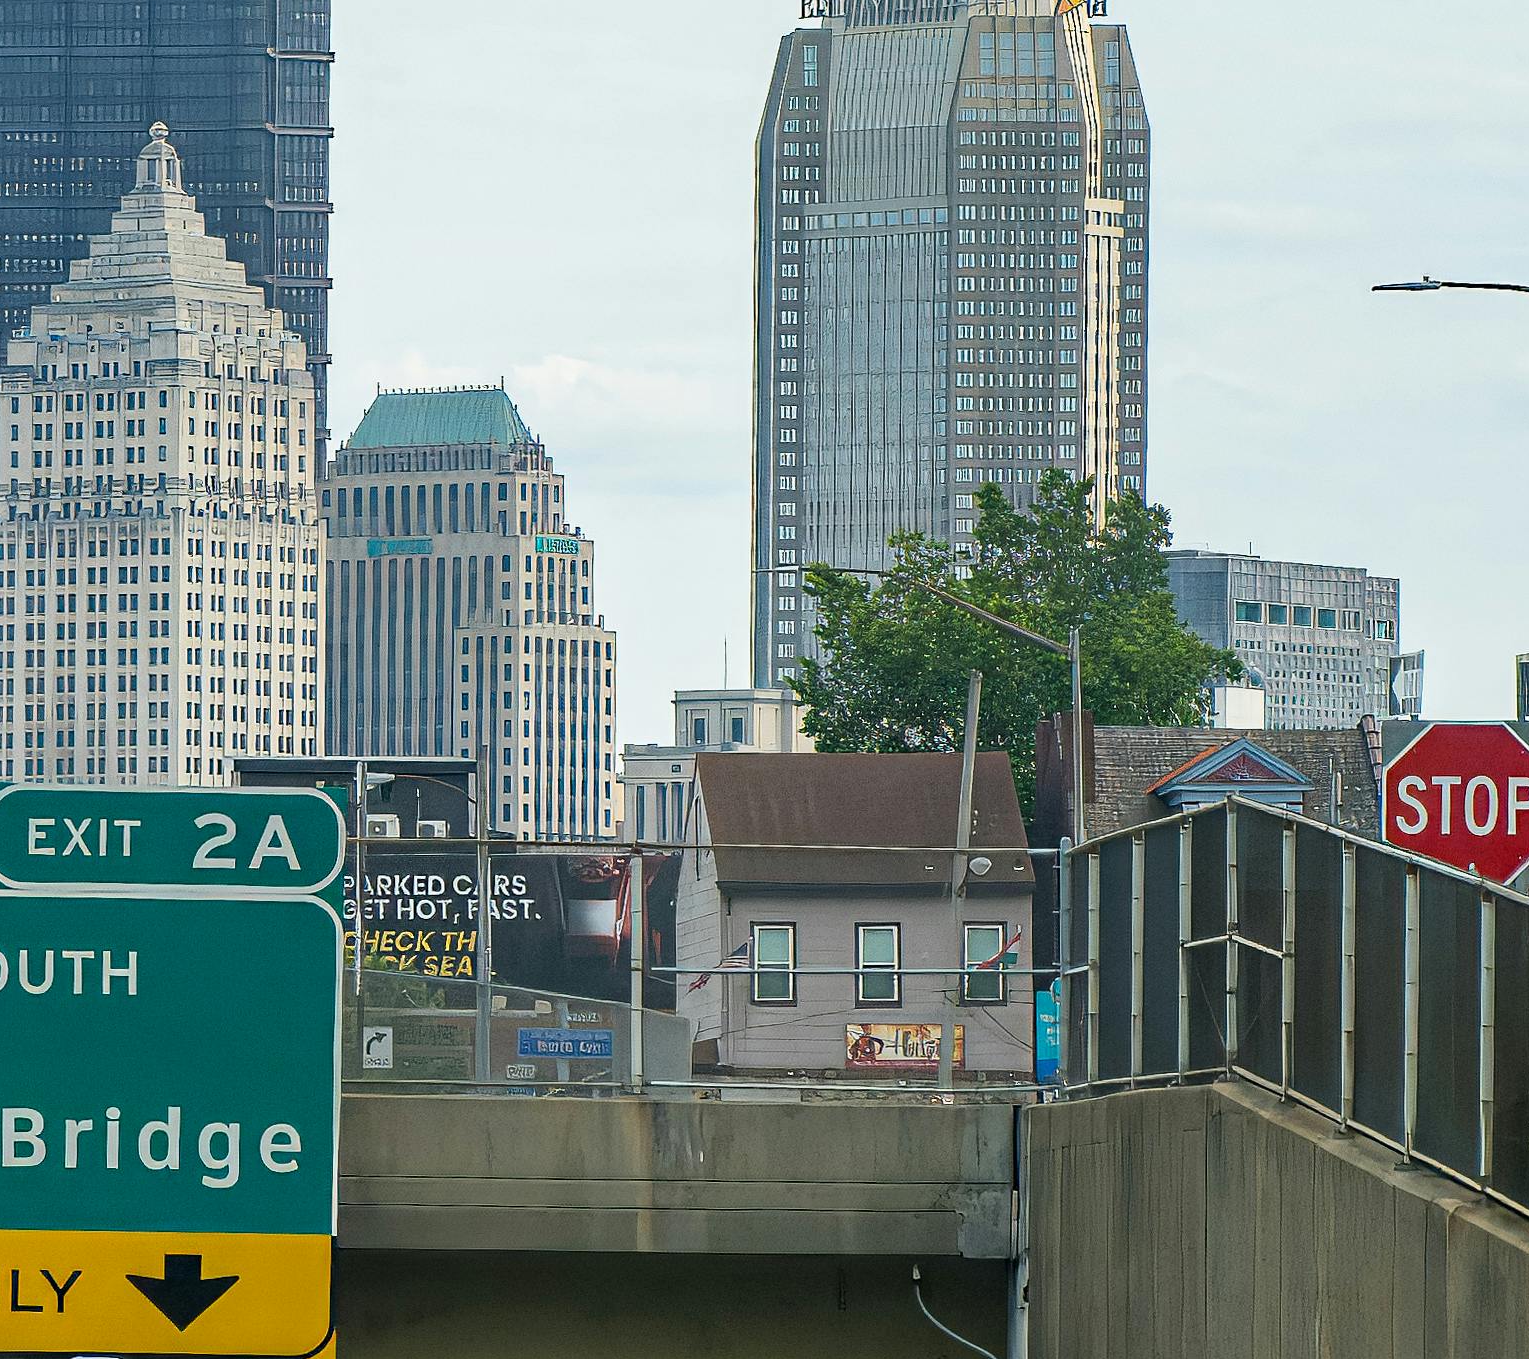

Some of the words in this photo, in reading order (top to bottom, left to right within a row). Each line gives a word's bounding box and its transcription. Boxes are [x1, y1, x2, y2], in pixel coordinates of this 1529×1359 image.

[27, 818, 143, 858] EXIT
[192, 813, 302, 871] 2A
[343, 874, 445, 897] PARKED
[452, 874, 527, 897] CRS
[343, 898, 389, 920] GET
[397, 898, 460, 925] HOT,
[344, 930, 436, 952] CHECK
[442, 930, 478, 952] TH
[1, 1105, 304, 1189] Bridge
